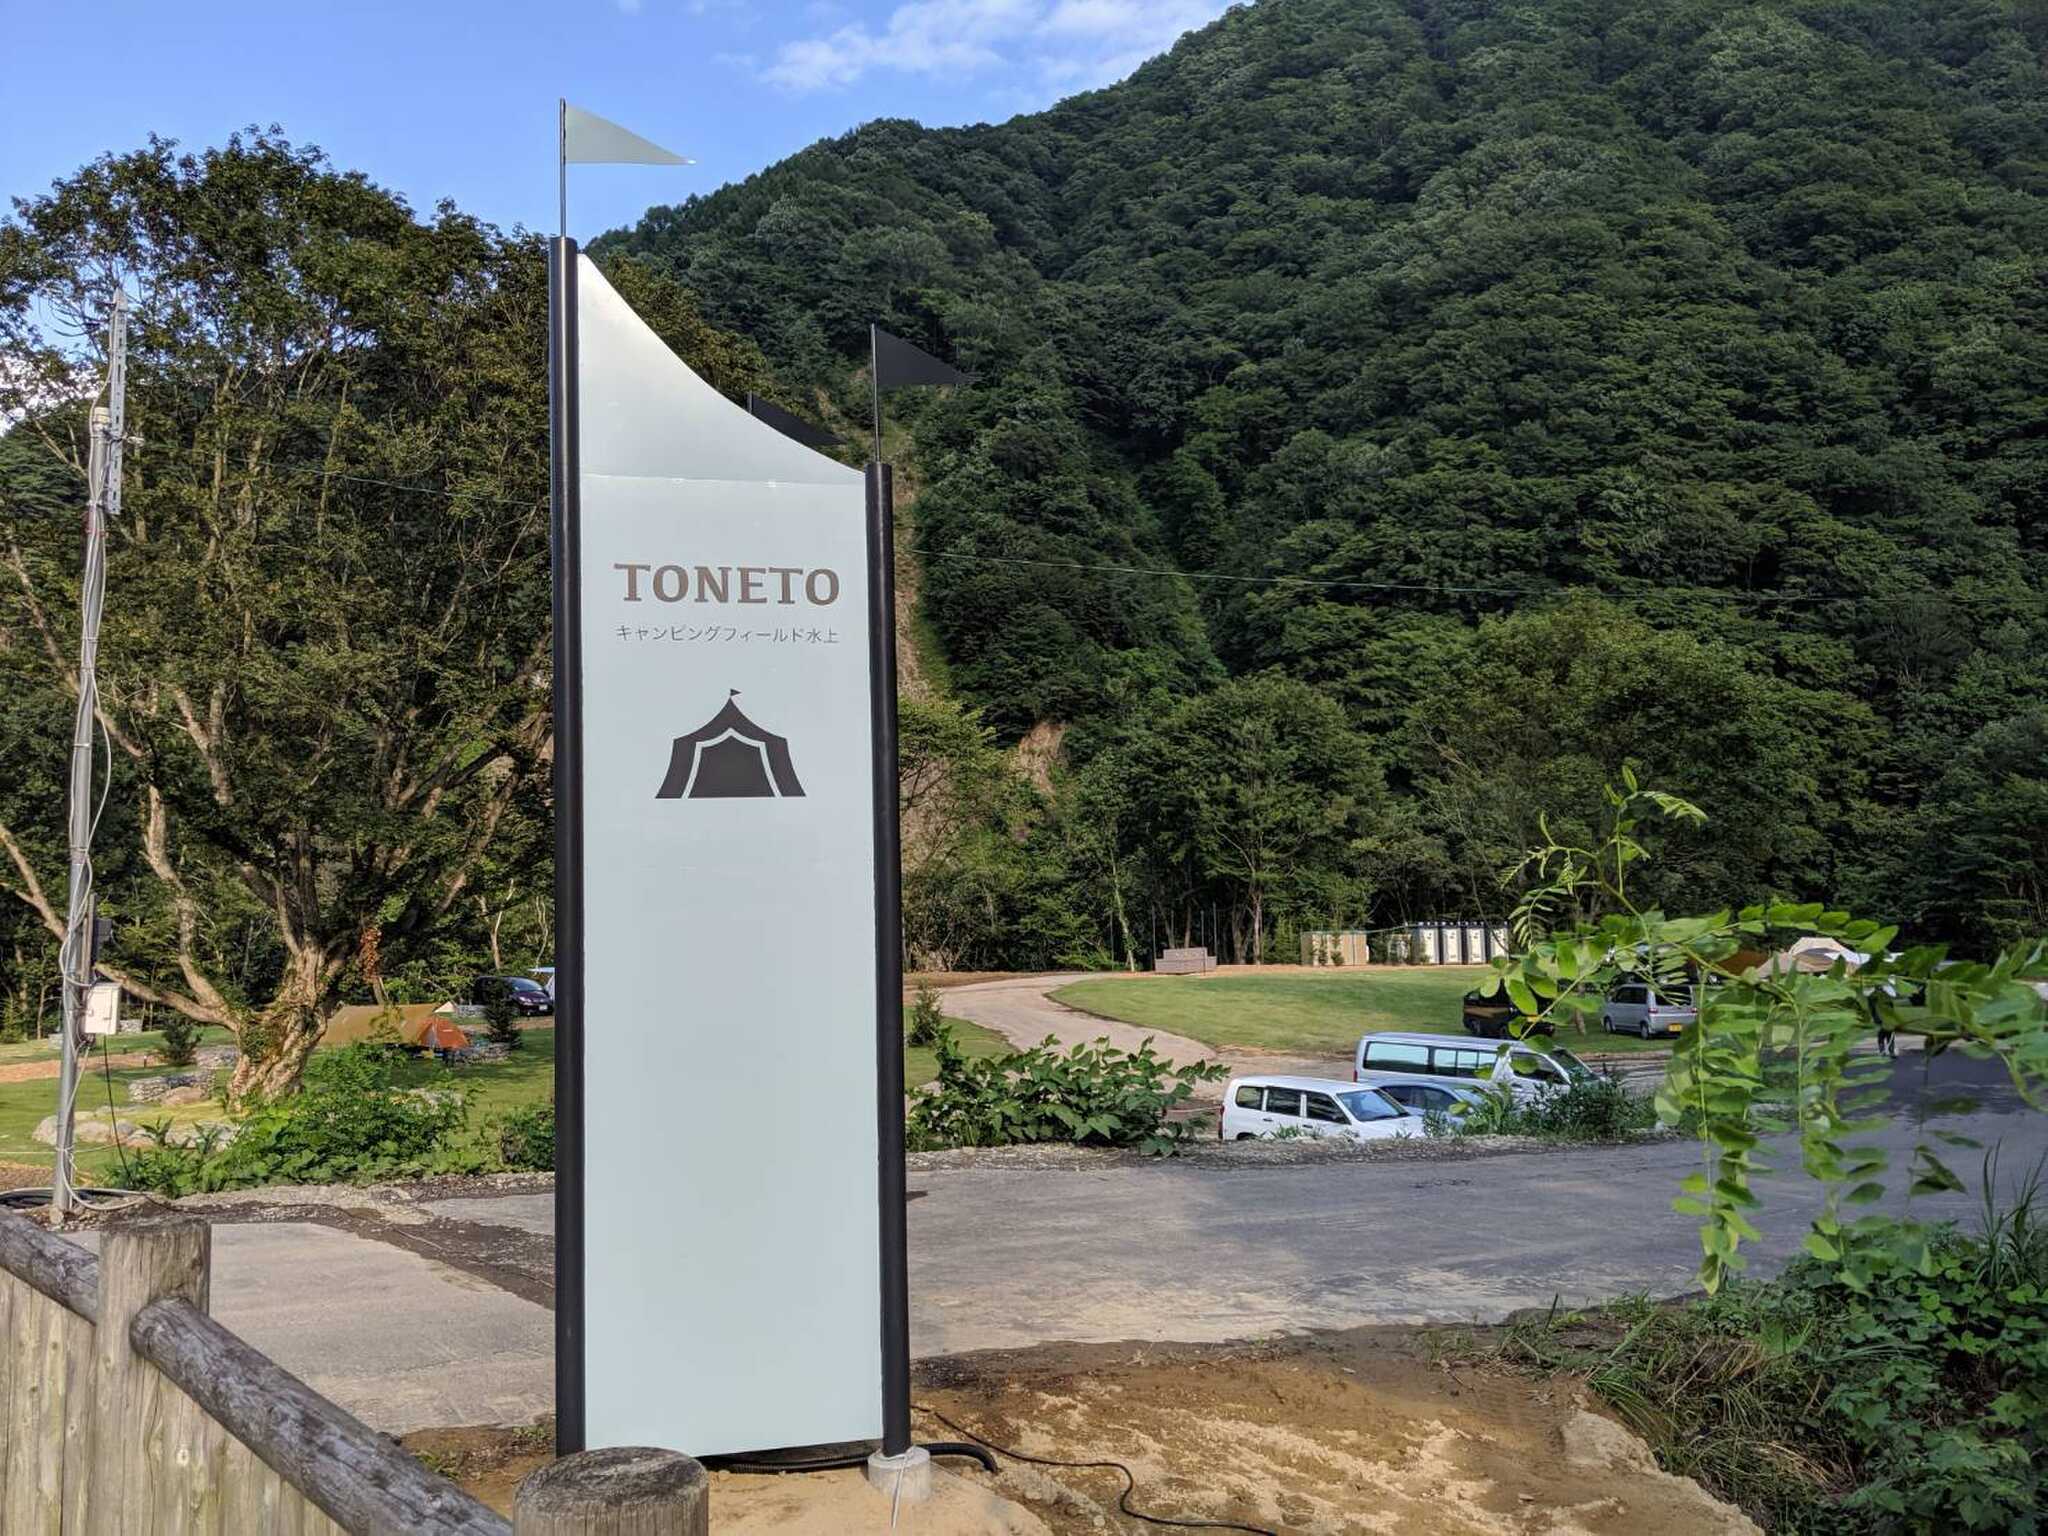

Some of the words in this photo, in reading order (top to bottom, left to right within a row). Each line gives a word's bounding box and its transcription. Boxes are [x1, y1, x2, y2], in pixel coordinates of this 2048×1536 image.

[614, 563, 840, 606] TONETO
[615, 624, 839, 644] キャンピングフィールド水上
